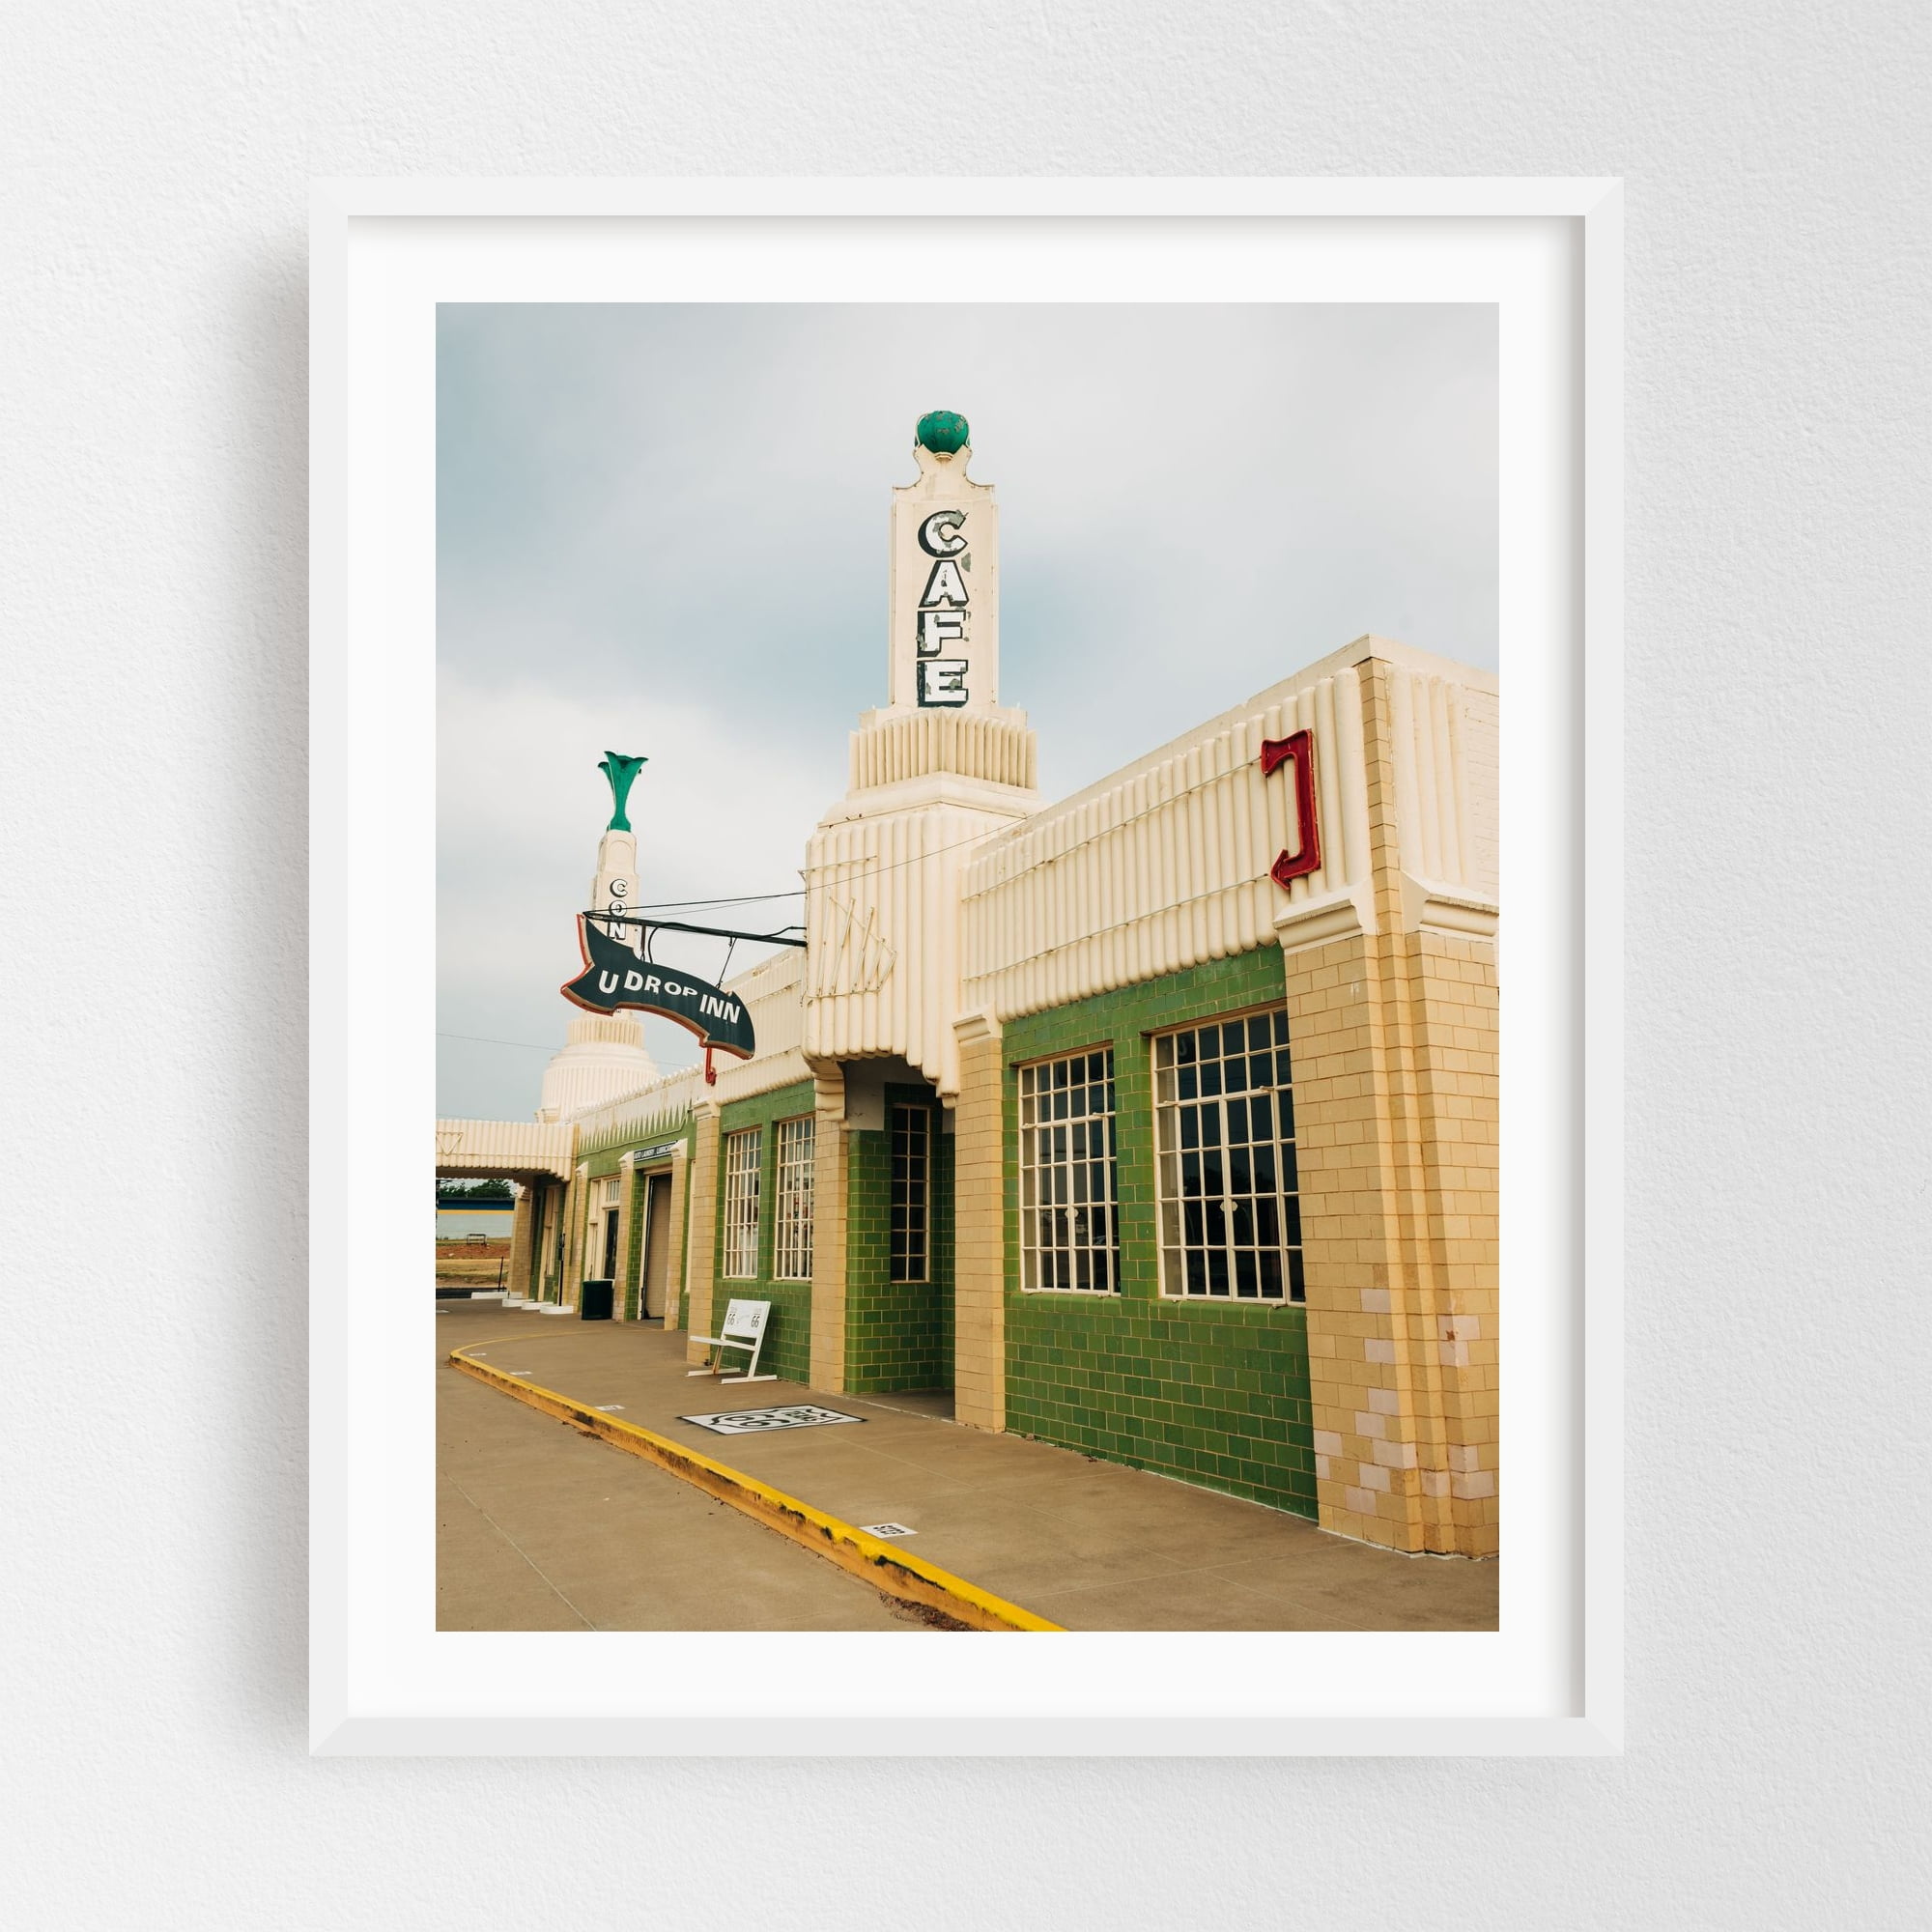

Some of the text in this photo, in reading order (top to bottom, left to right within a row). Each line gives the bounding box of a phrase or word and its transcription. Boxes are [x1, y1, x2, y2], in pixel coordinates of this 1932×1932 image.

[917, 509, 969, 708] CAFE
[609, 878, 628, 941] CON
[598, 970, 741, 1025] U DROP INN
